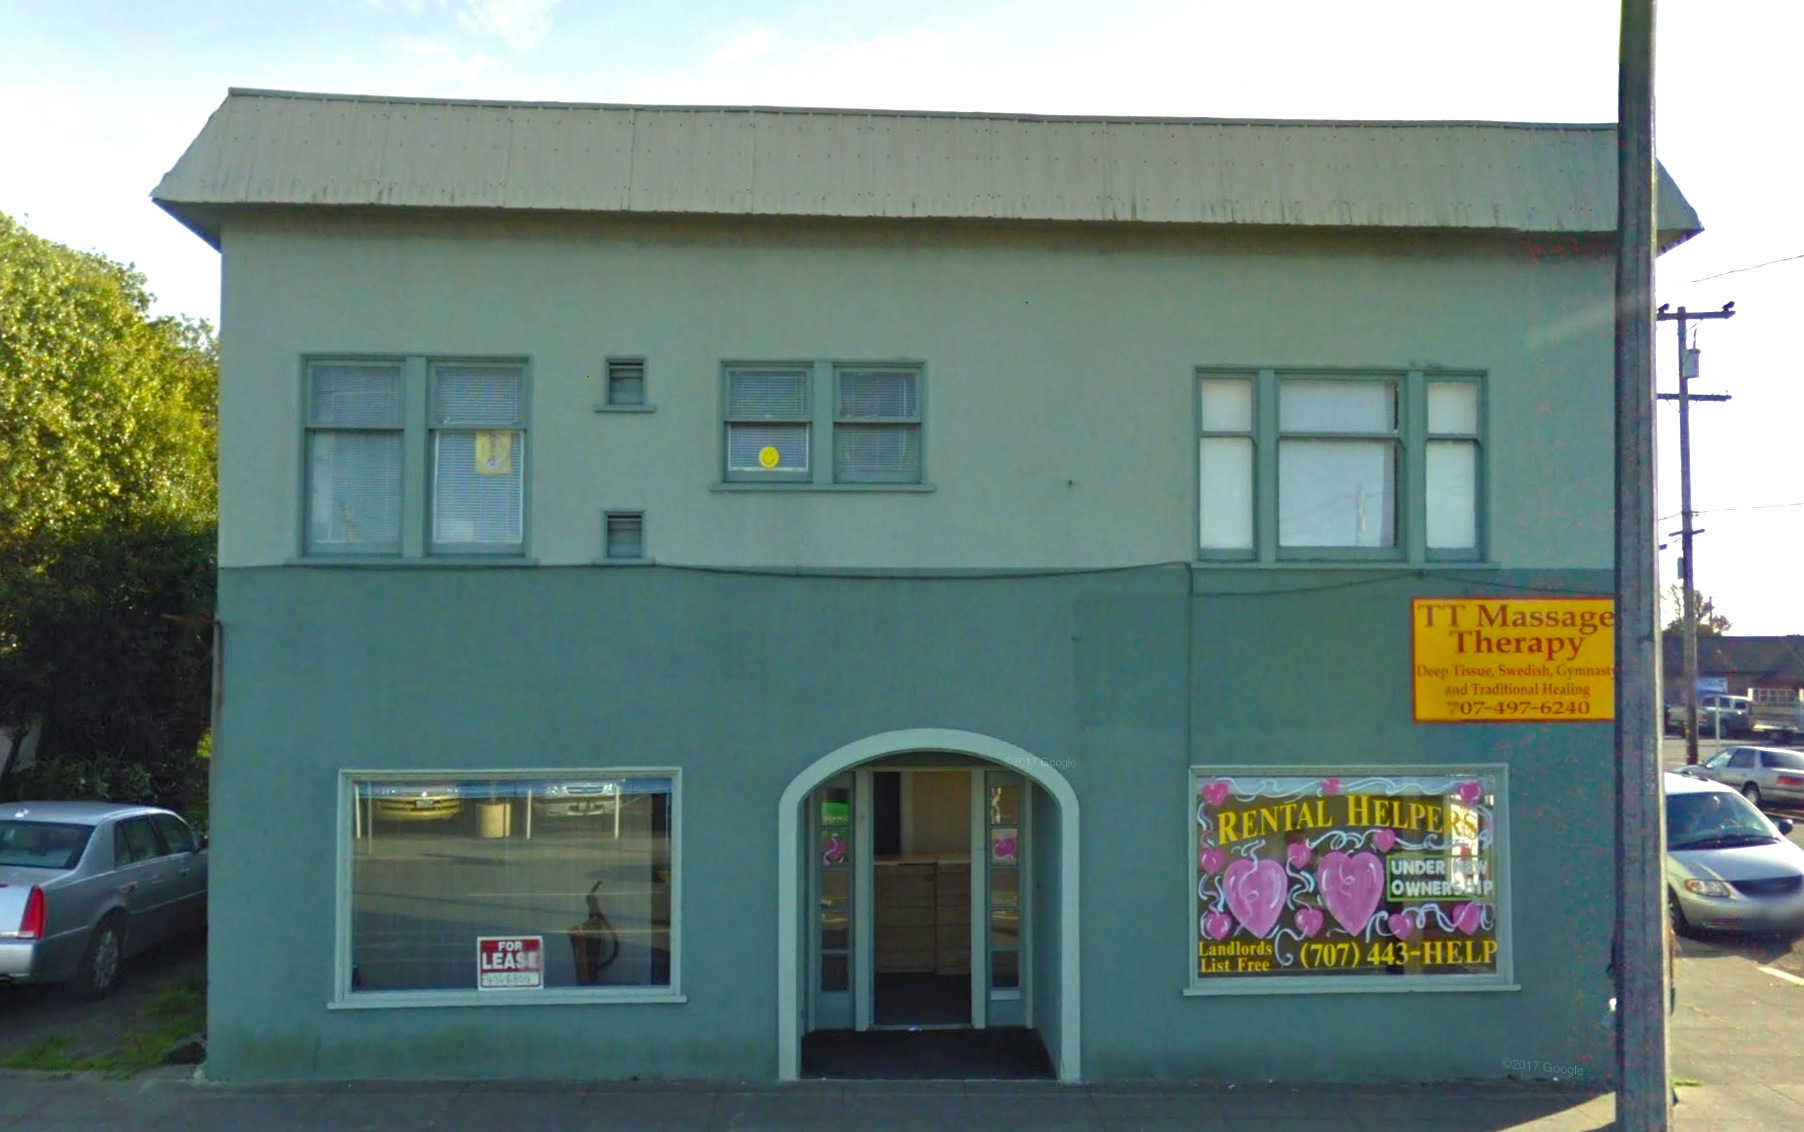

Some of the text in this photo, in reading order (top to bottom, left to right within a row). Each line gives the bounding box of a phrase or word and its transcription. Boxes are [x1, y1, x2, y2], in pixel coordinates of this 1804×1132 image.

[1417, 604, 1615, 635] TT Massage
[1449, 630, 1585, 661] Therapy
[1417, 664, 1448, 680] Deep
[1453, 664, 1495, 678] Tissue,
[1498, 664, 1552, 678] Swedish,
[1445, 682, 1590, 698] and Traditional Healing
[1447, 701, 1590, 716] 707-497-6240
[1391, 859, 1446, 875] UNDER
[498, 941, 522, 951] FOR
[1199, 941, 1273, 957] Landlords
[1301, 939, 1498, 969] (707) 443-HELP
[482, 952, 539, 970] LEASE
[1201, 957, 1270, 973] List Free
